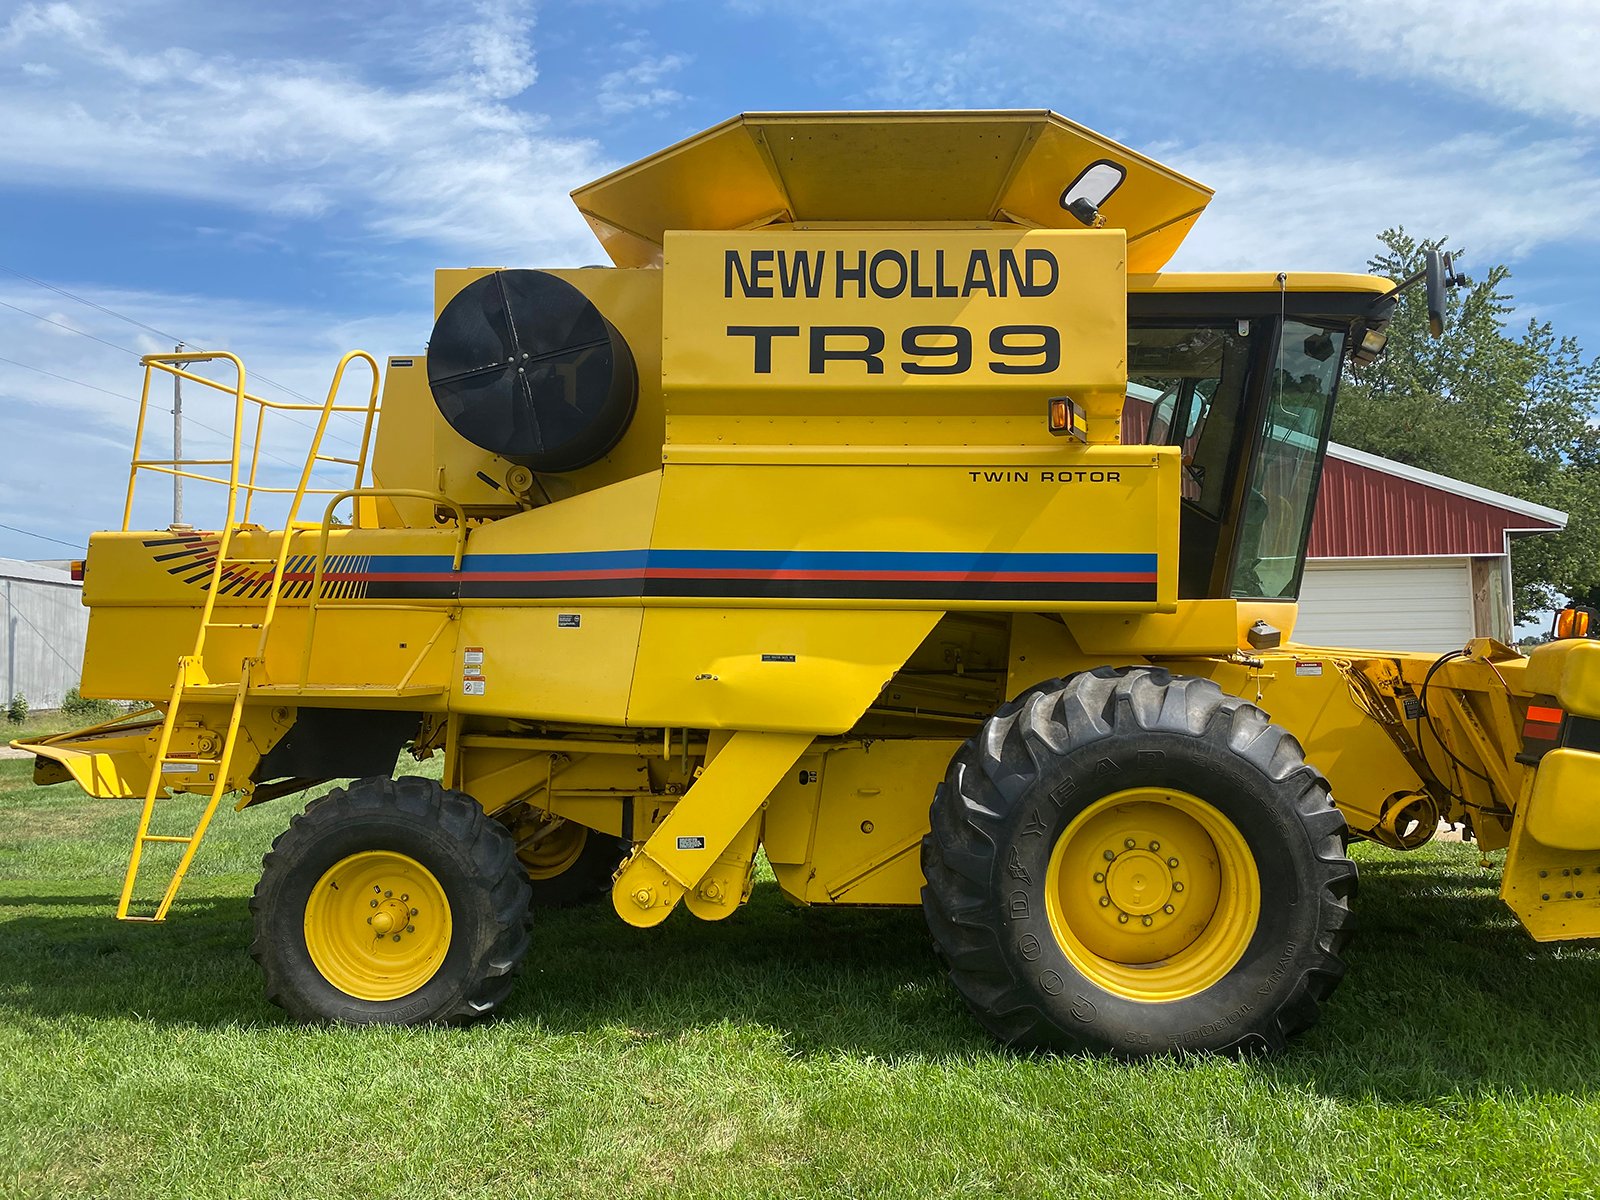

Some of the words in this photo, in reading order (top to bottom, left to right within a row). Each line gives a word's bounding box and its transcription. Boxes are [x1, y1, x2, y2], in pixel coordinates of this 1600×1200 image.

[724, 249, 826, 299] NEW
[835, 248, 1060, 299] HOLLAND
[726, 324, 1062, 376] TR99
[968, 471, 1029, 483] TWIN
[1040, 471, 1121, 483] ROTOR
[1008, 749, 1167, 1024] GOODYEAR
[1256, 939, 1297, 998] DYNA
